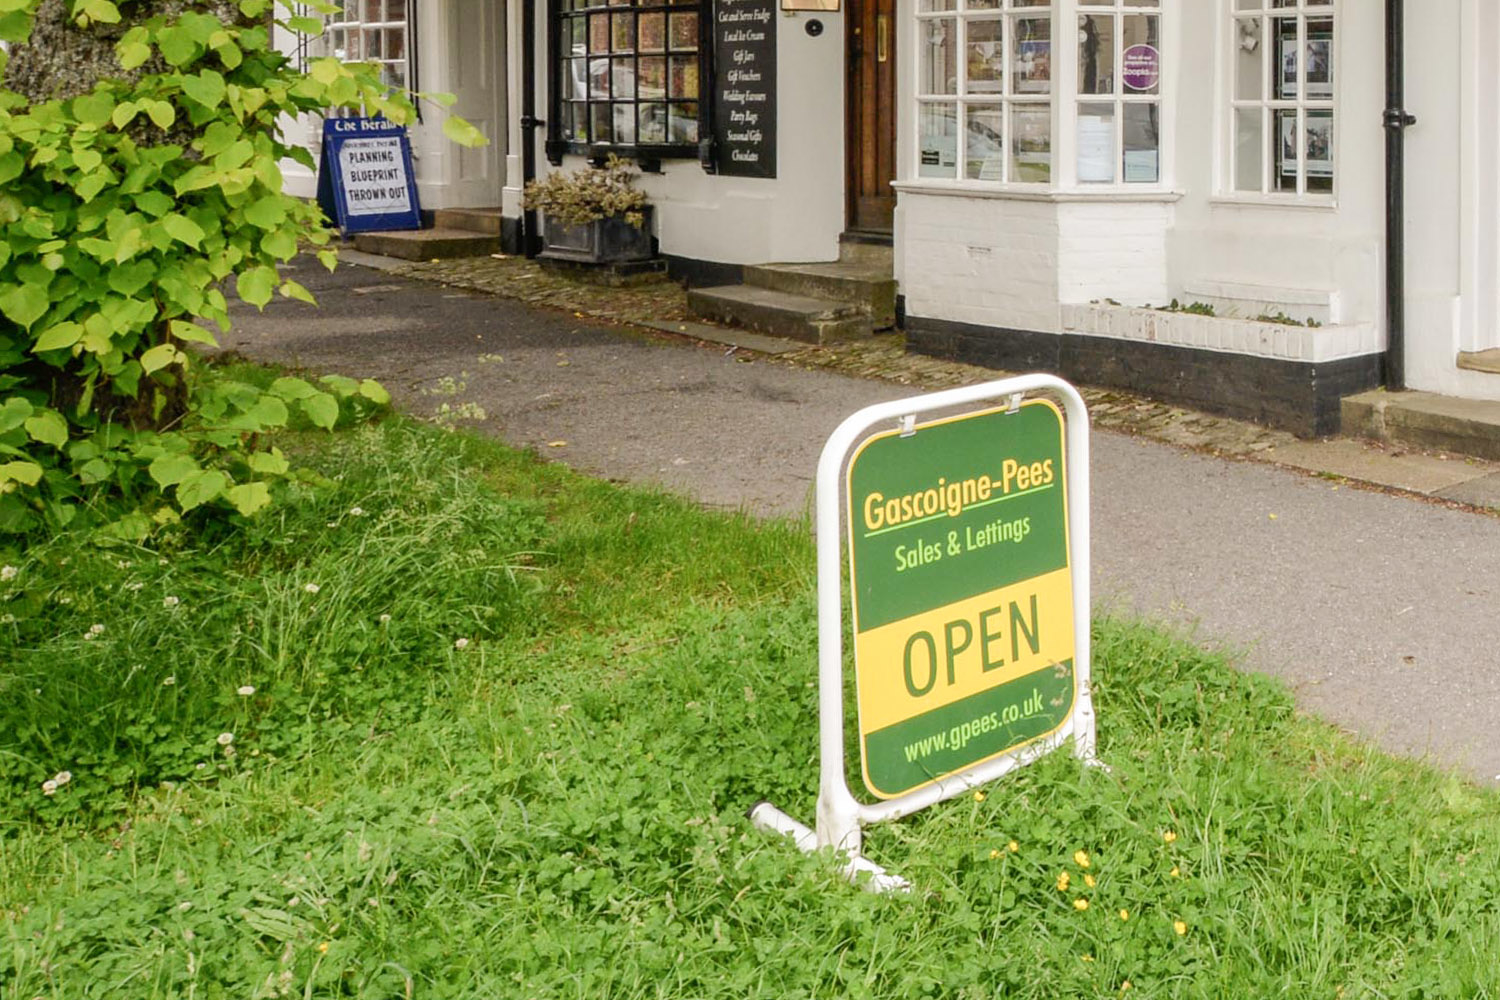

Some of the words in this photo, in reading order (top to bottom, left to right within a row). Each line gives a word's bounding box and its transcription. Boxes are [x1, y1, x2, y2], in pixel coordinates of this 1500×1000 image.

[349, 151, 394, 164] PLANNING
[350, 168, 398, 182] BLUEPRINT
[349, 189, 387, 201] THROWN
[389, 187, 405, 199] OUT
[864, 459, 1053, 530] Gascoigne-Pees
[895, 539, 942, 572] Sales
[947, 531, 960, 556] &
[966, 517, 1031, 551] Lettings
[903, 594, 1040, 698] OPEN
[904, 688, 1044, 763] www.gpees.co.uk
